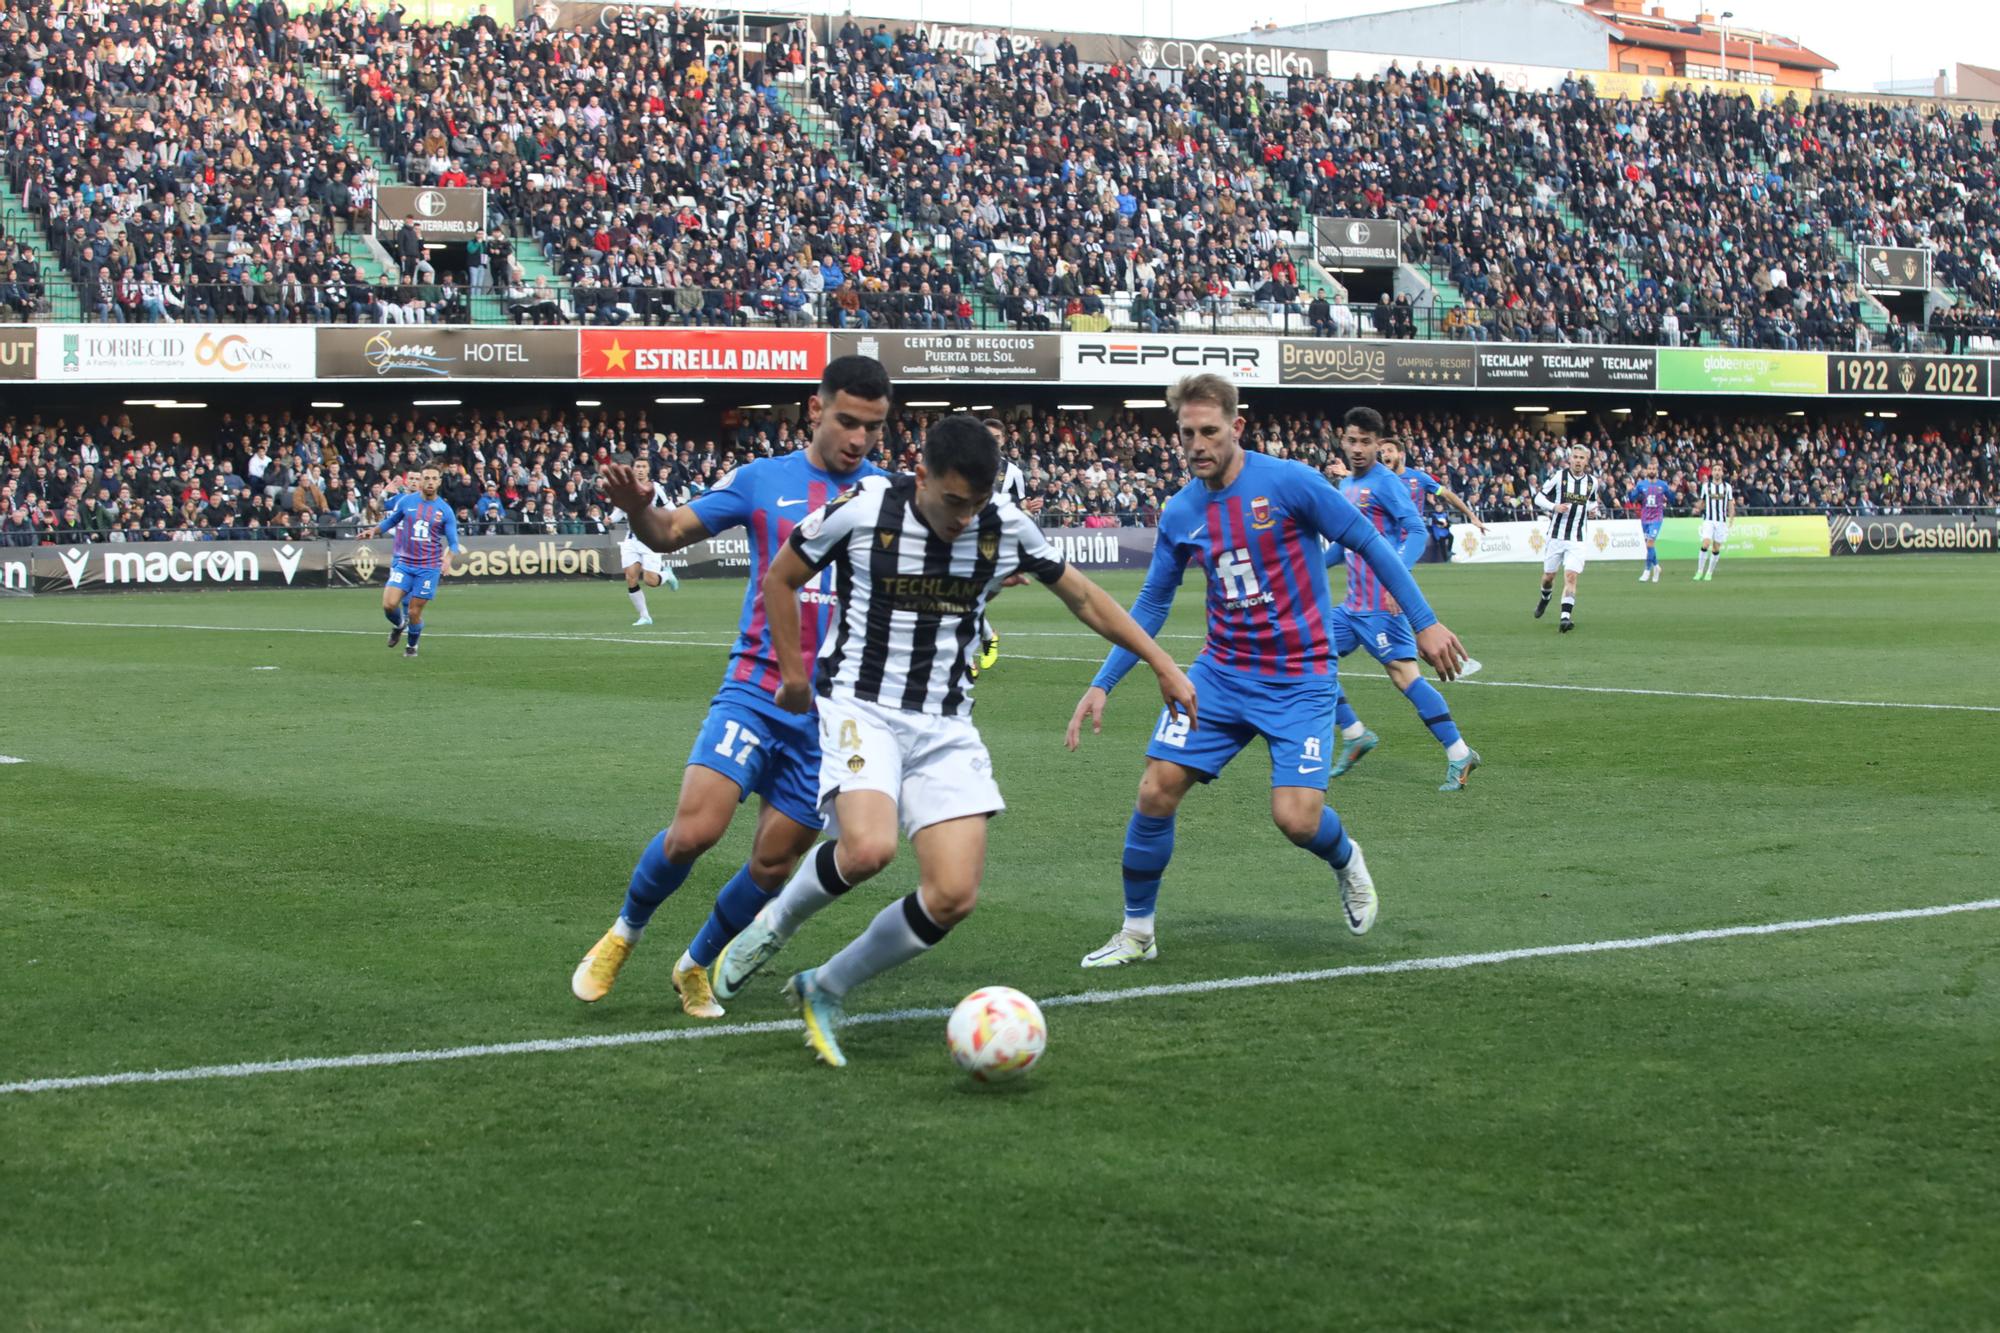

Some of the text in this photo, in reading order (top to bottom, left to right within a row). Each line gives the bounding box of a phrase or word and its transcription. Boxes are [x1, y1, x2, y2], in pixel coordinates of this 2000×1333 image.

[1, 342, 35, 366] UT
[85, 339, 184, 357] TORRECID
[464, 344, 529, 362] HOTEL
[904, 337, 1035, 350] CENTRO DE NEGOCIOS
[635, 349, 808, 370] ESTRELLA DAMM
[925, 350, 1015, 363] PUERTA DEL SOL
[1078, 344, 1260, 366] REPCAR
[1283, 344, 1385, 372] Bravoplaya
[1397, 357, 1433, 368] CAMPING
[1440, 358, 1471, 369] RESORT
[1492, 370, 1528, 378] LEVANTINA
[1554, 371, 1589, 379] LEVANTINA
[1613, 373, 1648, 381] LEVANTINA
[1837, 360, 1978, 392] 1922 2022
[707, 540, 750, 554] TECHL
[0, 561, 27, 589] n
[104, 550, 259, 584] macron
[839, 719, 863, 750] 4
[1155, 709, 1191, 748] 12
[715, 720, 760, 766] 17
